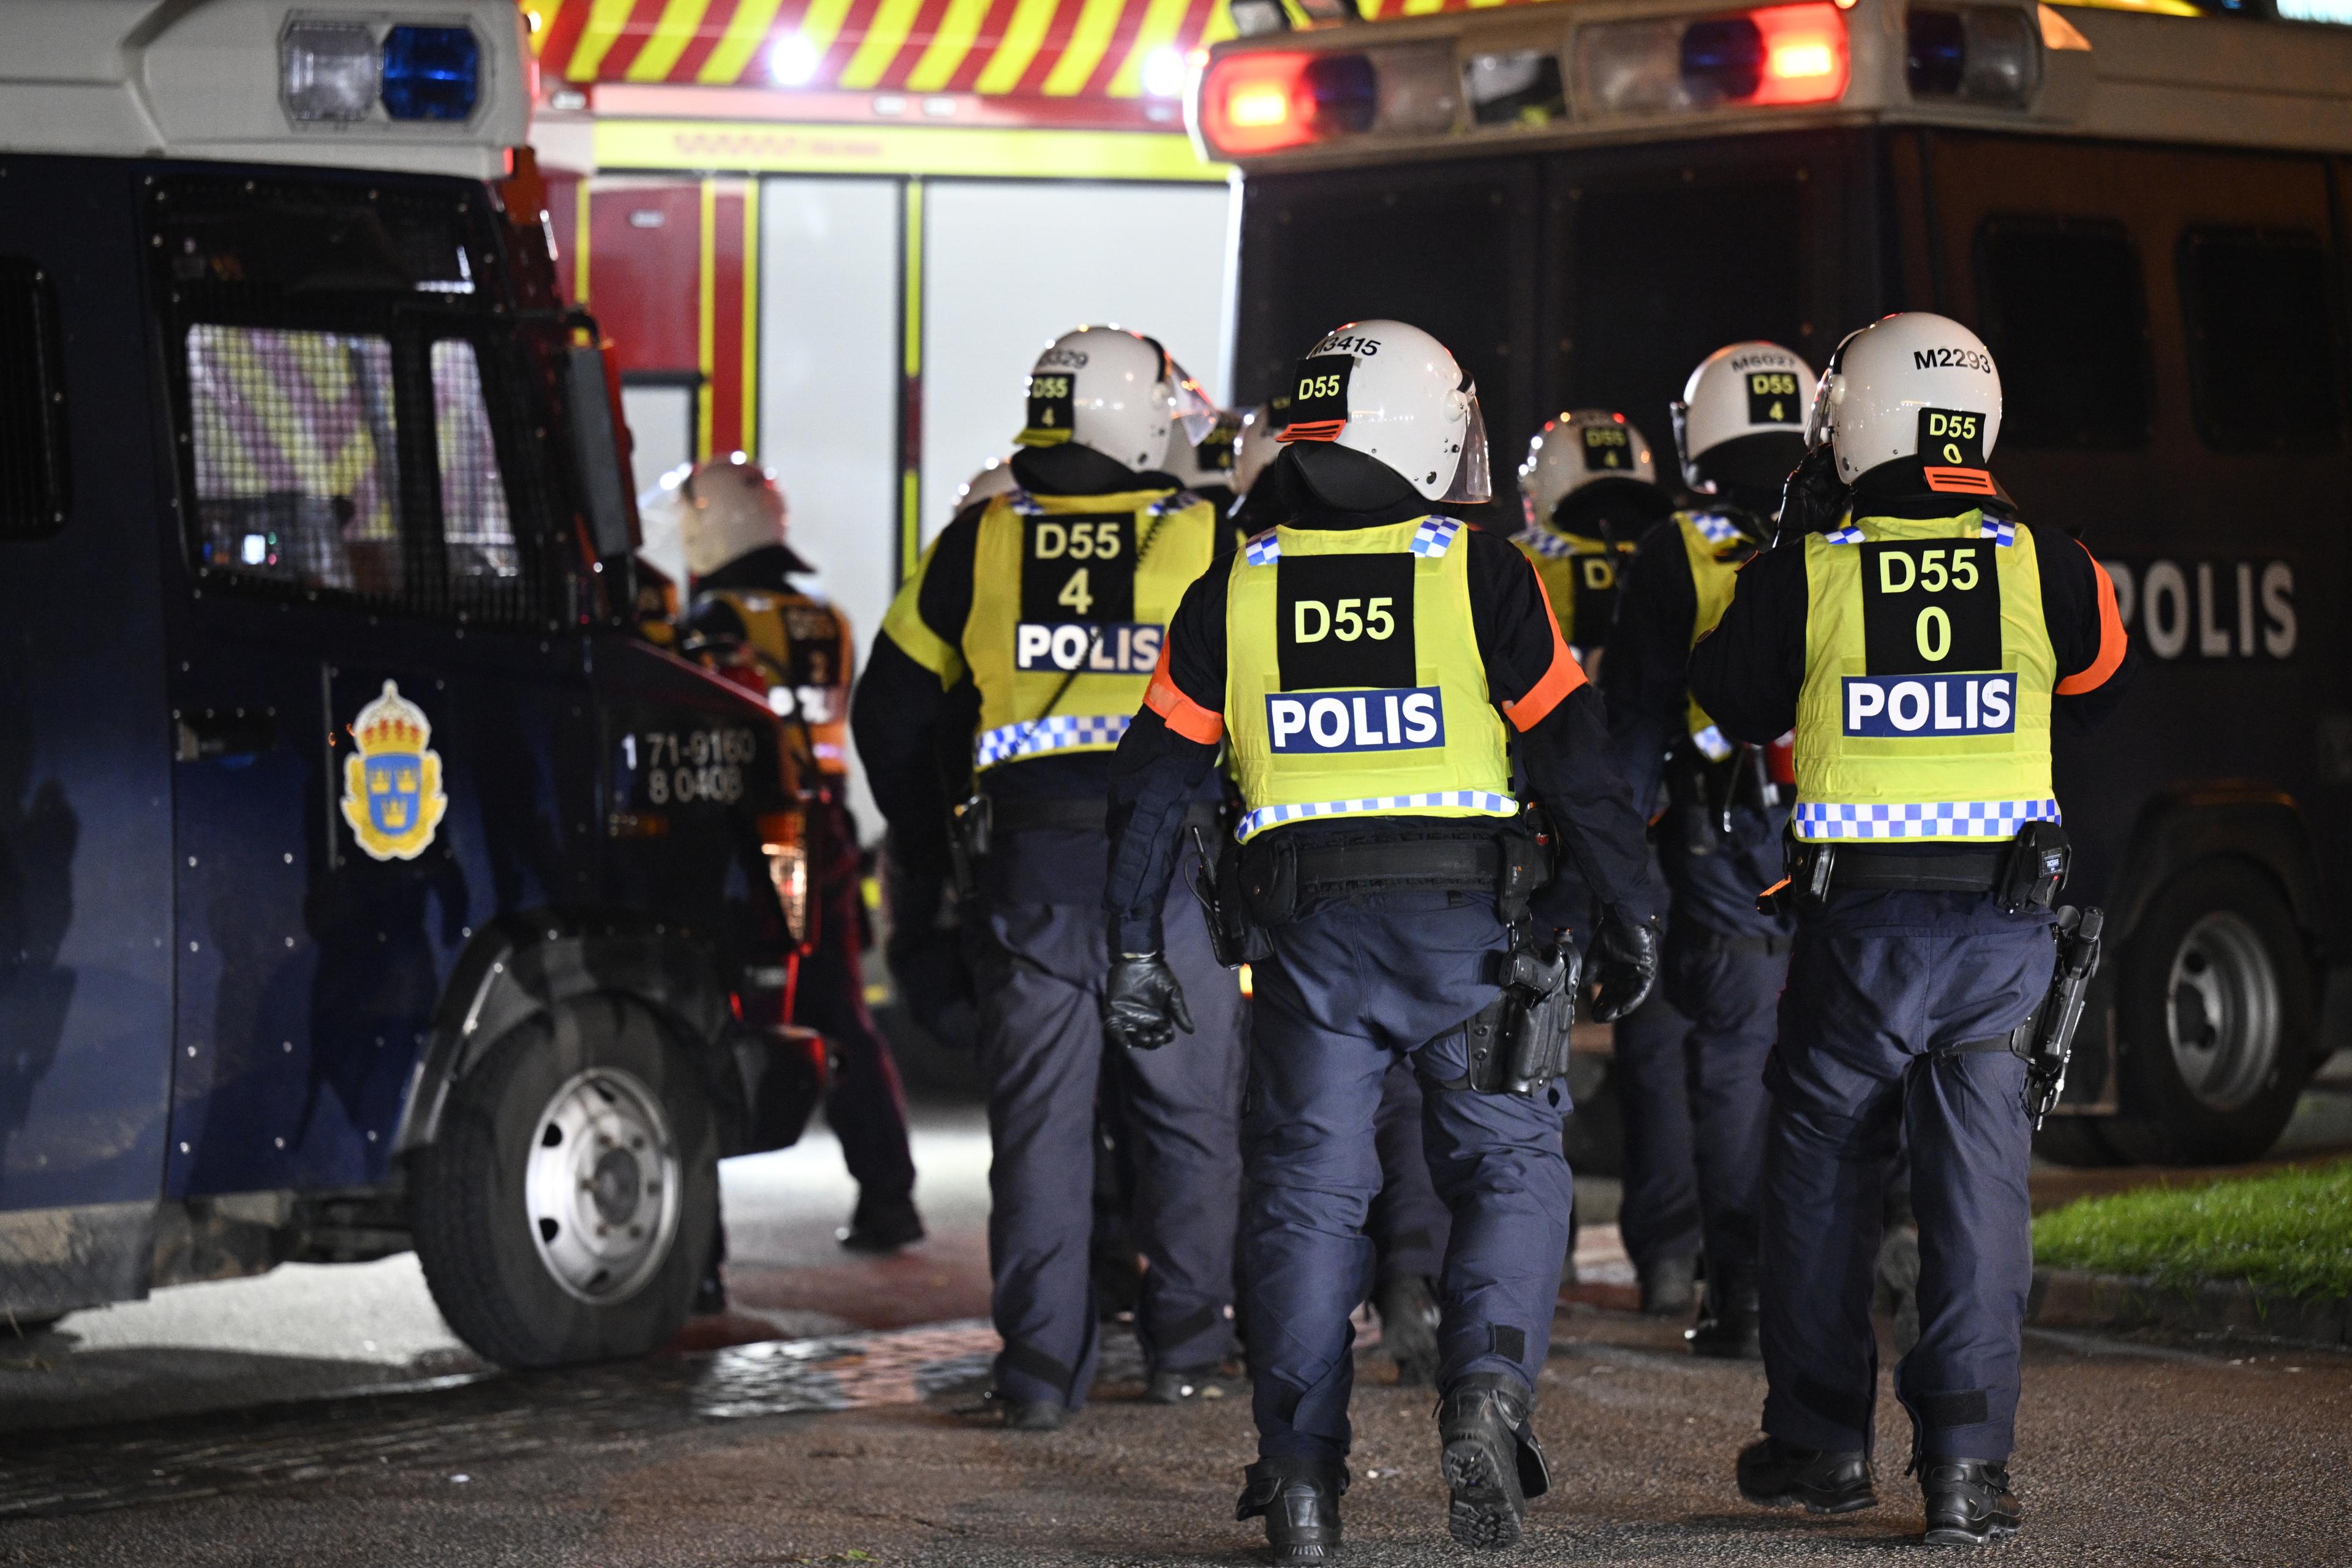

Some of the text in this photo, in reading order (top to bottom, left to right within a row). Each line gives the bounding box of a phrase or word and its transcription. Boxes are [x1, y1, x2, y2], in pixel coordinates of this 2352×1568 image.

[1913, 348, 1991, 375] M2293
[1031, 376, 1069, 399] D55
[1298, 375, 1341, 401] D55
[1752, 374, 1796, 396] D55
[1769, 400, 1785, 423] 4
[1929, 413, 1976, 440] D55
[1943, 443, 1962, 465] 0
[1035, 522, 1121, 560] D55
[1879, 548, 1980, 594] D55
[1058, 567, 1094, 616] 4
[1294, 597, 1395, 644] D55
[1915, 606, 1952, 662] 0
[1017, 623, 1160, 671] POLIS
[1271, 693, 1438, 748] POLIS
[1848, 678, 2011, 732] POLIS
